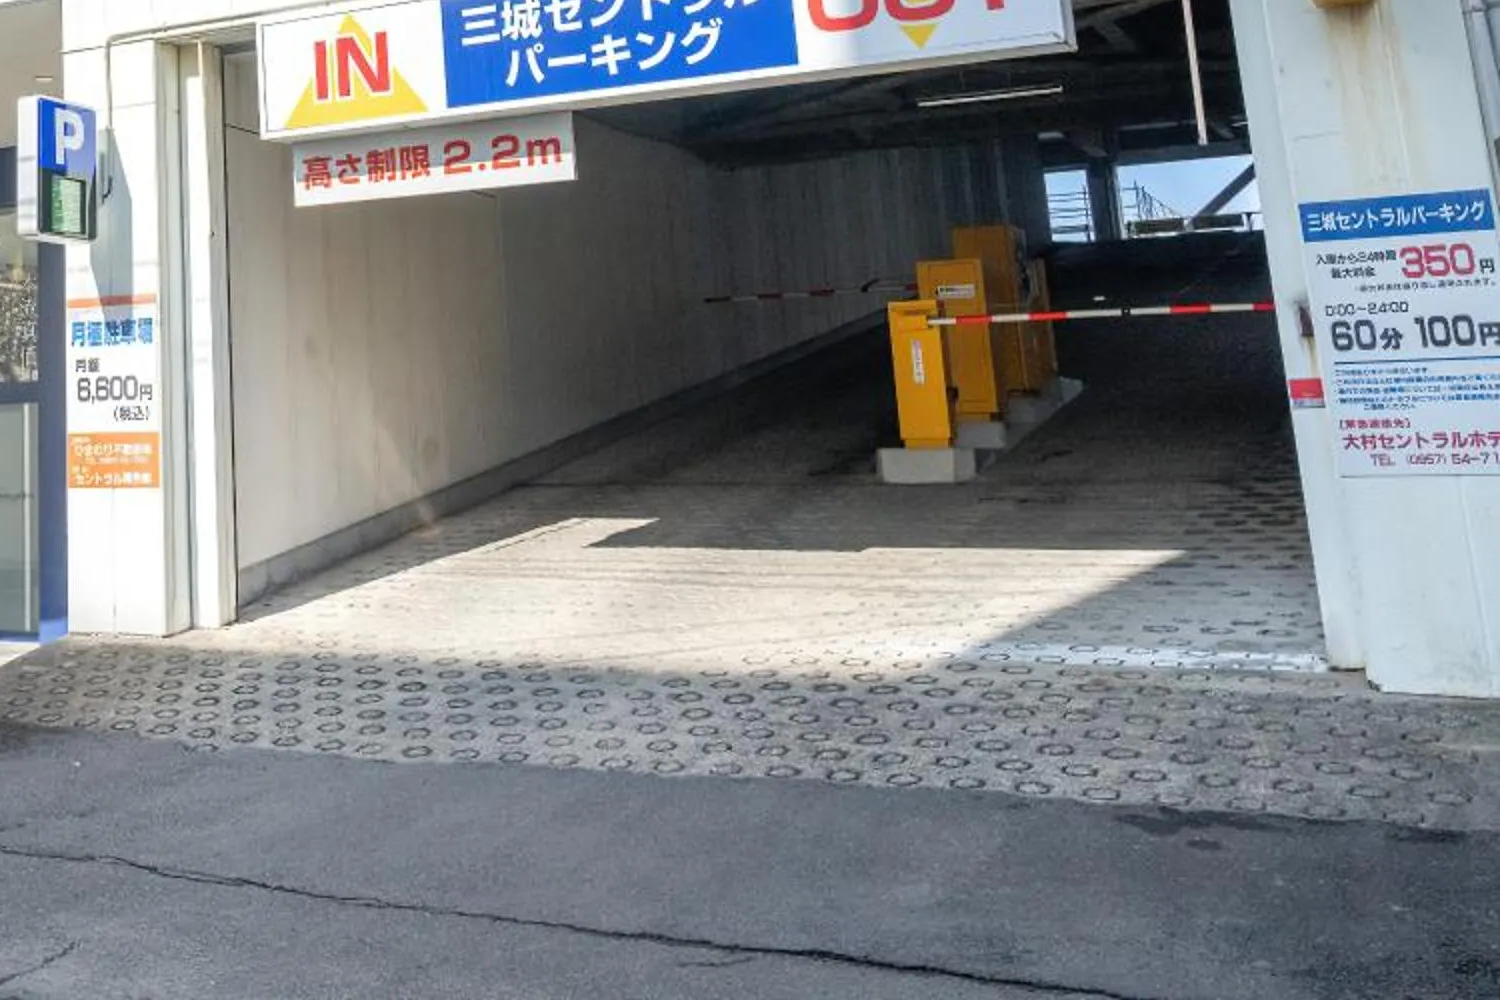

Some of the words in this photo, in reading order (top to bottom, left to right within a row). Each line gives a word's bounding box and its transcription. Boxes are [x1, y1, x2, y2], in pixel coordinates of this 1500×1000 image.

[313, 31, 390, 100] IN
[505, 17, 723, 88] パーキング
[53, 107, 85, 166] P
[302, 143, 431, 191] 高さ制限
[443, 133, 563, 175] 2.2m
[1306, 201, 1485, 232] 三城セントラルパーキング
[1331, 319, 1404, 352] 60分
[1414, 314, 1500, 348] 100円
